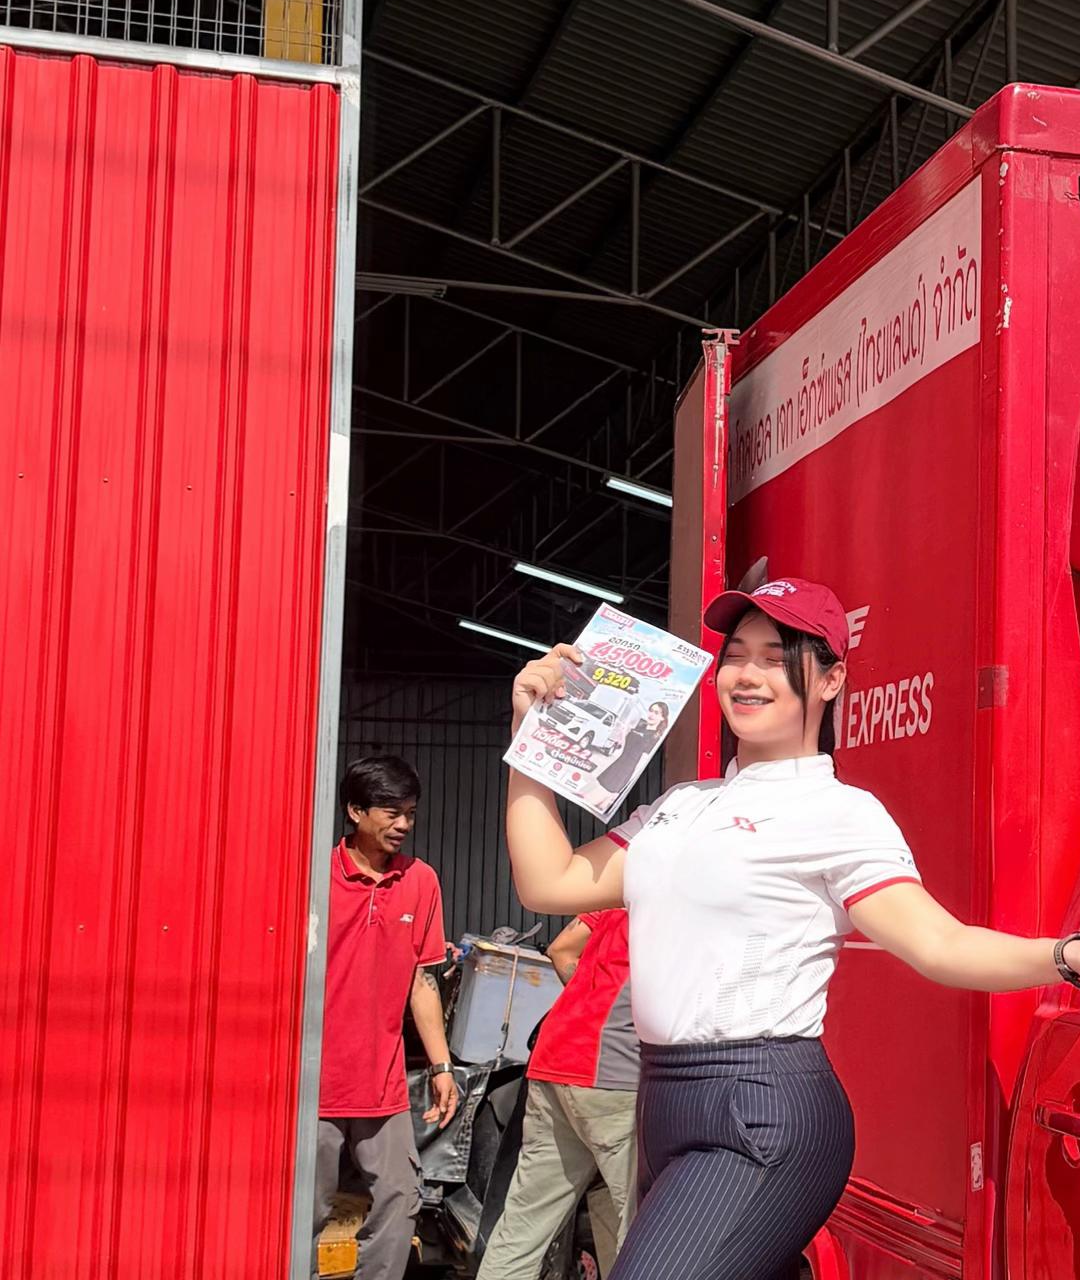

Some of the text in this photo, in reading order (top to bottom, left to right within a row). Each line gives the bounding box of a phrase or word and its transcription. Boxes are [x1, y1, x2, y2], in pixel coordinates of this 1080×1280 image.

[932, 245, 978, 342] จำกัด
[592, 668, 632, 689] 9,320
[847, 671, 935, 749] EXPRESS
